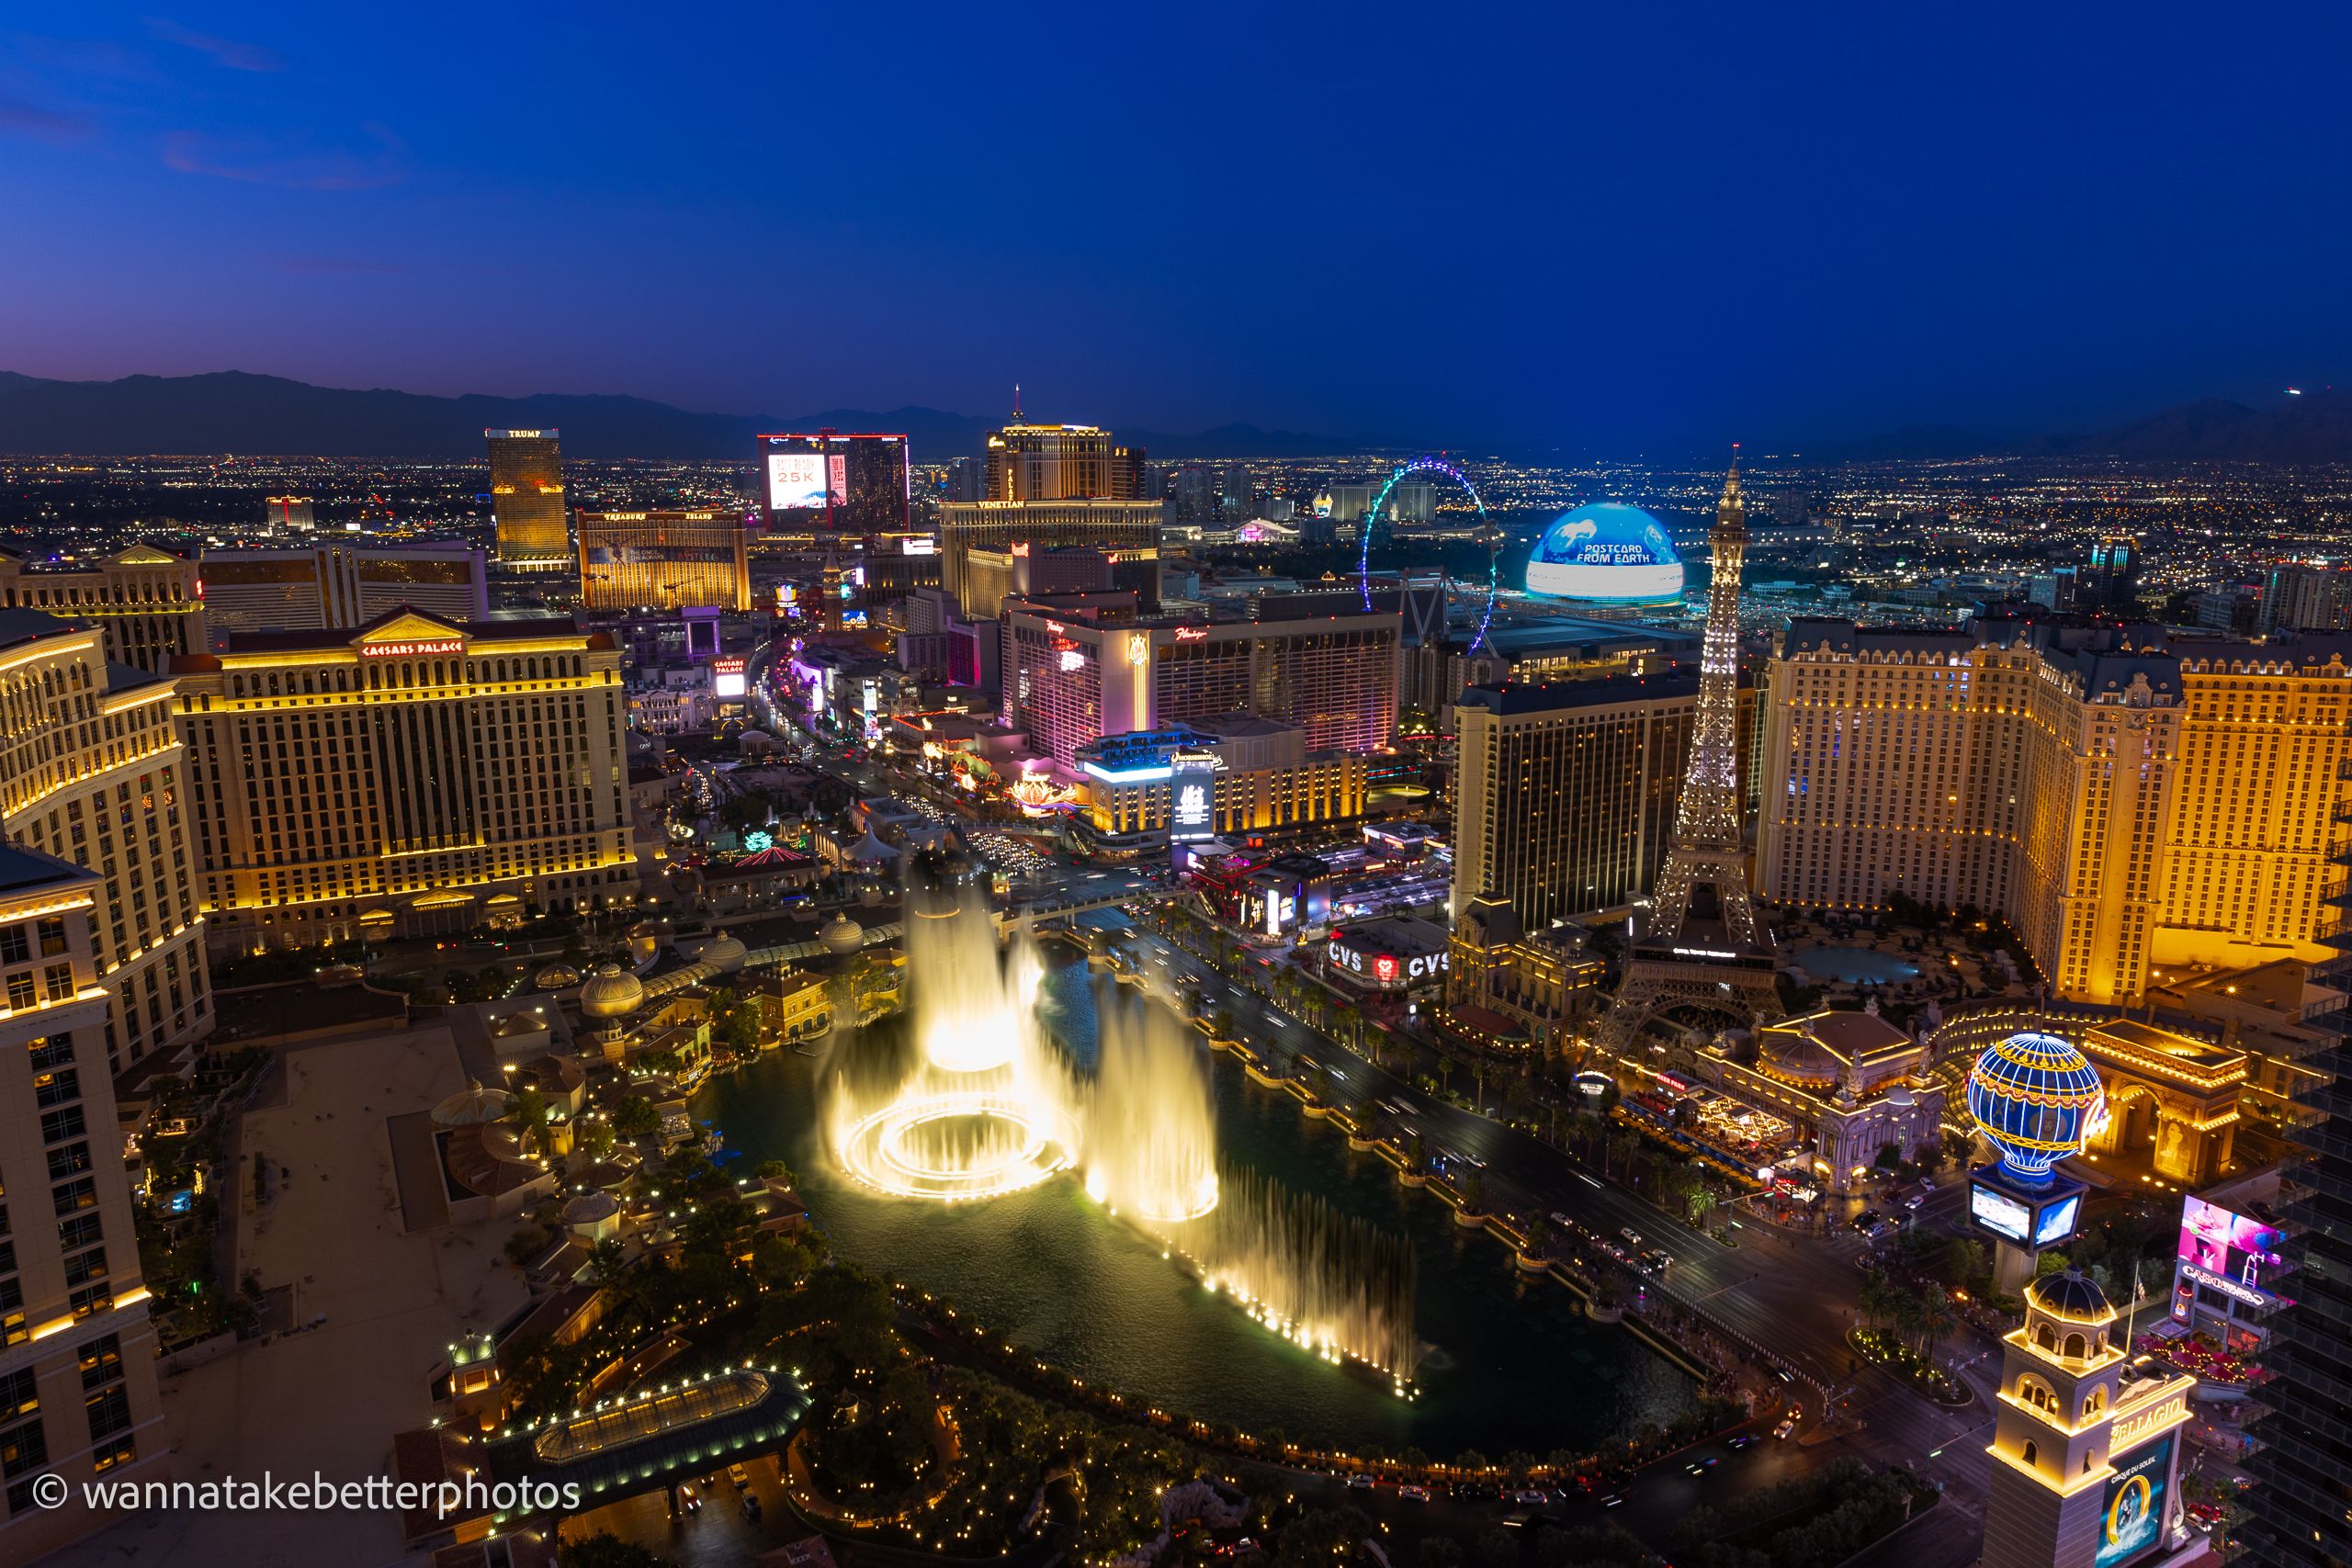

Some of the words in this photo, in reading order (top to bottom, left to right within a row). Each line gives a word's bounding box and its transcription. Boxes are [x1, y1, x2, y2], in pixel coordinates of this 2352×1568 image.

[508, 430, 541, 438] TRUMP
[778, 472, 814, 482] 25K
[978, 501, 1024, 509] VENETIAN
[1585, 544, 1643, 553] POSTCARD
[1577, 553, 1611, 563] FROM
[1614, 554, 1650, 563] EARTH
[362, 645, 414, 656] CAESARS
[417, 642, 462, 653] PALACE
[1329, 942, 1362, 972] CVS
[1408, 952, 1449, 976] CVS
[1657, 1075, 1670, 1084] BEER
[1671, 1079, 1685, 1091] PARK
[2109, 1397, 2182, 1448] BELLAGIO
[2110, 1468, 2131, 1484] CIRQUE
[2131, 1464, 2139, 1474] DU
[2139, 1455, 2156, 1470] SOLEIL
